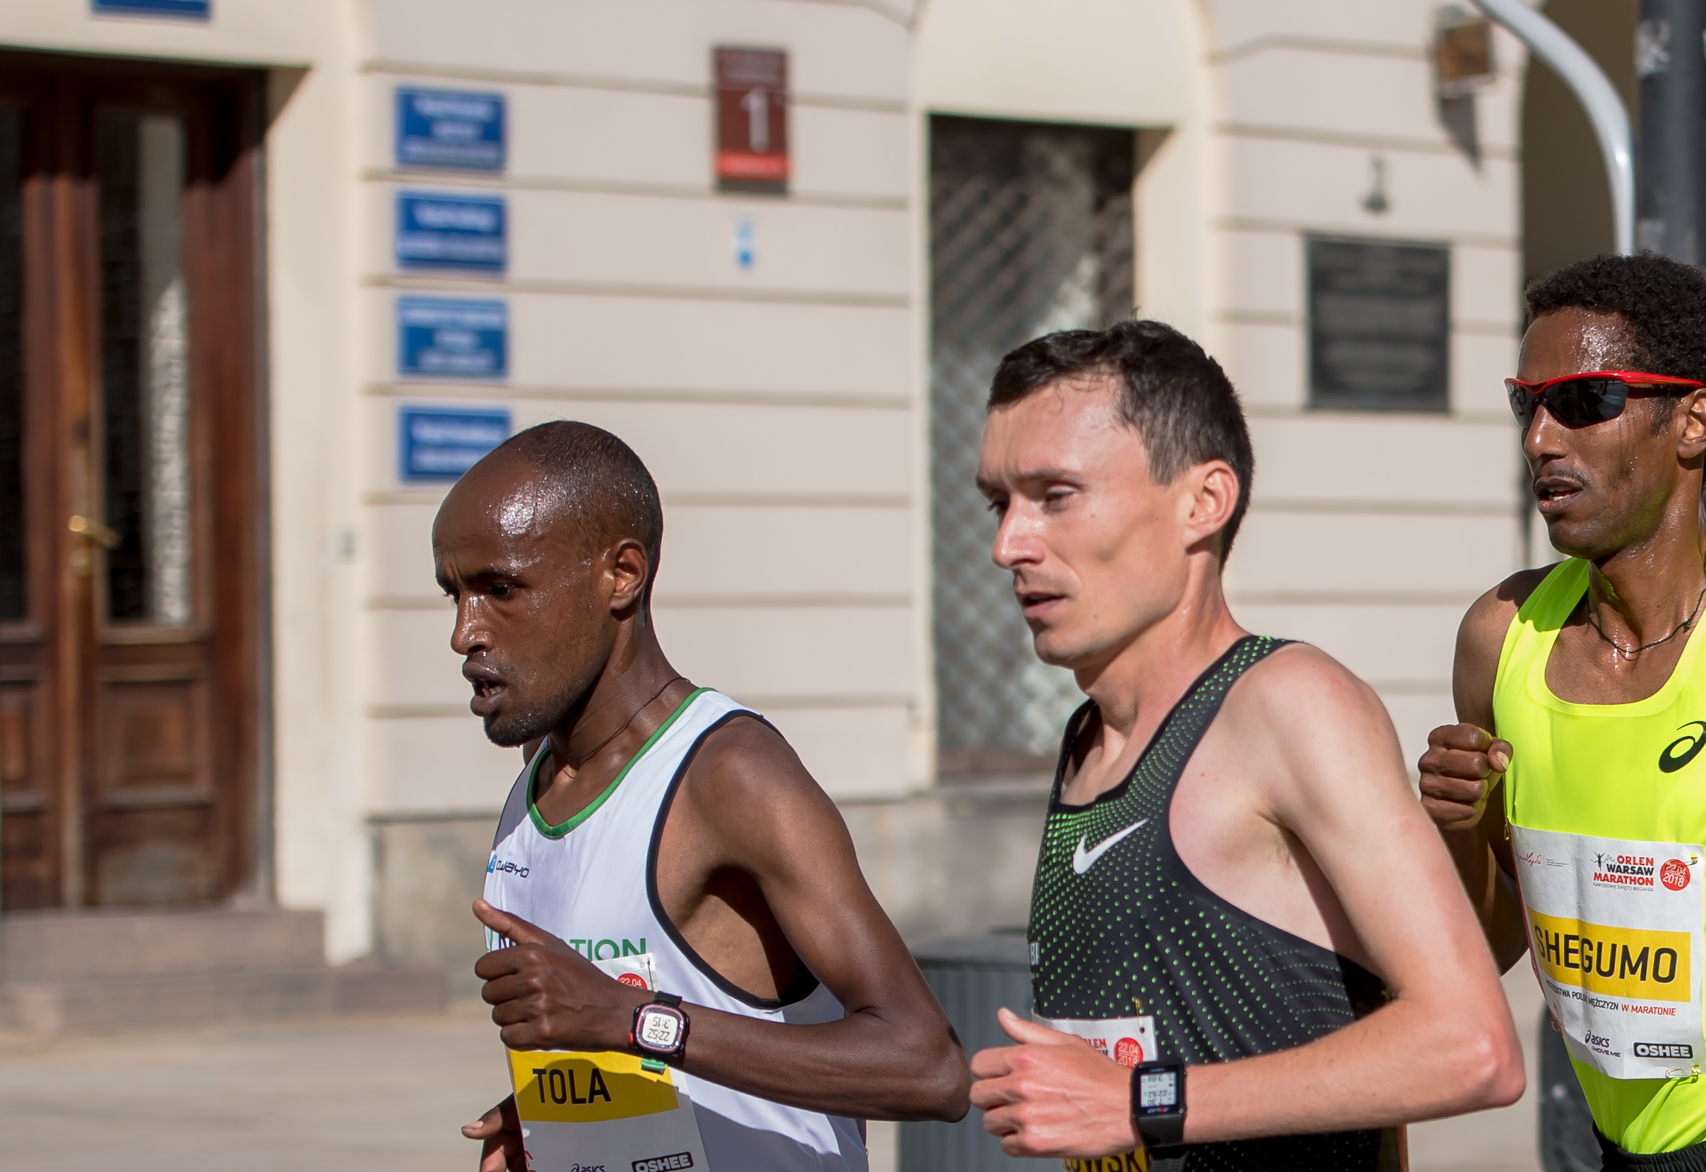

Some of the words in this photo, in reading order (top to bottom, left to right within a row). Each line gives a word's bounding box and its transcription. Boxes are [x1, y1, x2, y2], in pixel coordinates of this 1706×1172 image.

[740, 87, 769, 152] 1
[1617, 855, 1654, 866] ORLEN
[1606, 863, 1655, 876] WARSAW
[1593, 872, 1654, 886] MARATHON
[1663, 873, 1685, 887] 2018
[559, 938, 646, 961] TION
[1534, 924, 1678, 984] SHEGUMO
[1621, 1003, 1630, 1012] W
[1631, 1005, 1676, 1016] MARATONIE
[1117, 1041, 1139, 1055] 22.04
[1591, 1034, 1610, 1048] asics
[1636, 1044, 1690, 1057] OSHEE
[532, 1068, 612, 1104] TOLA
